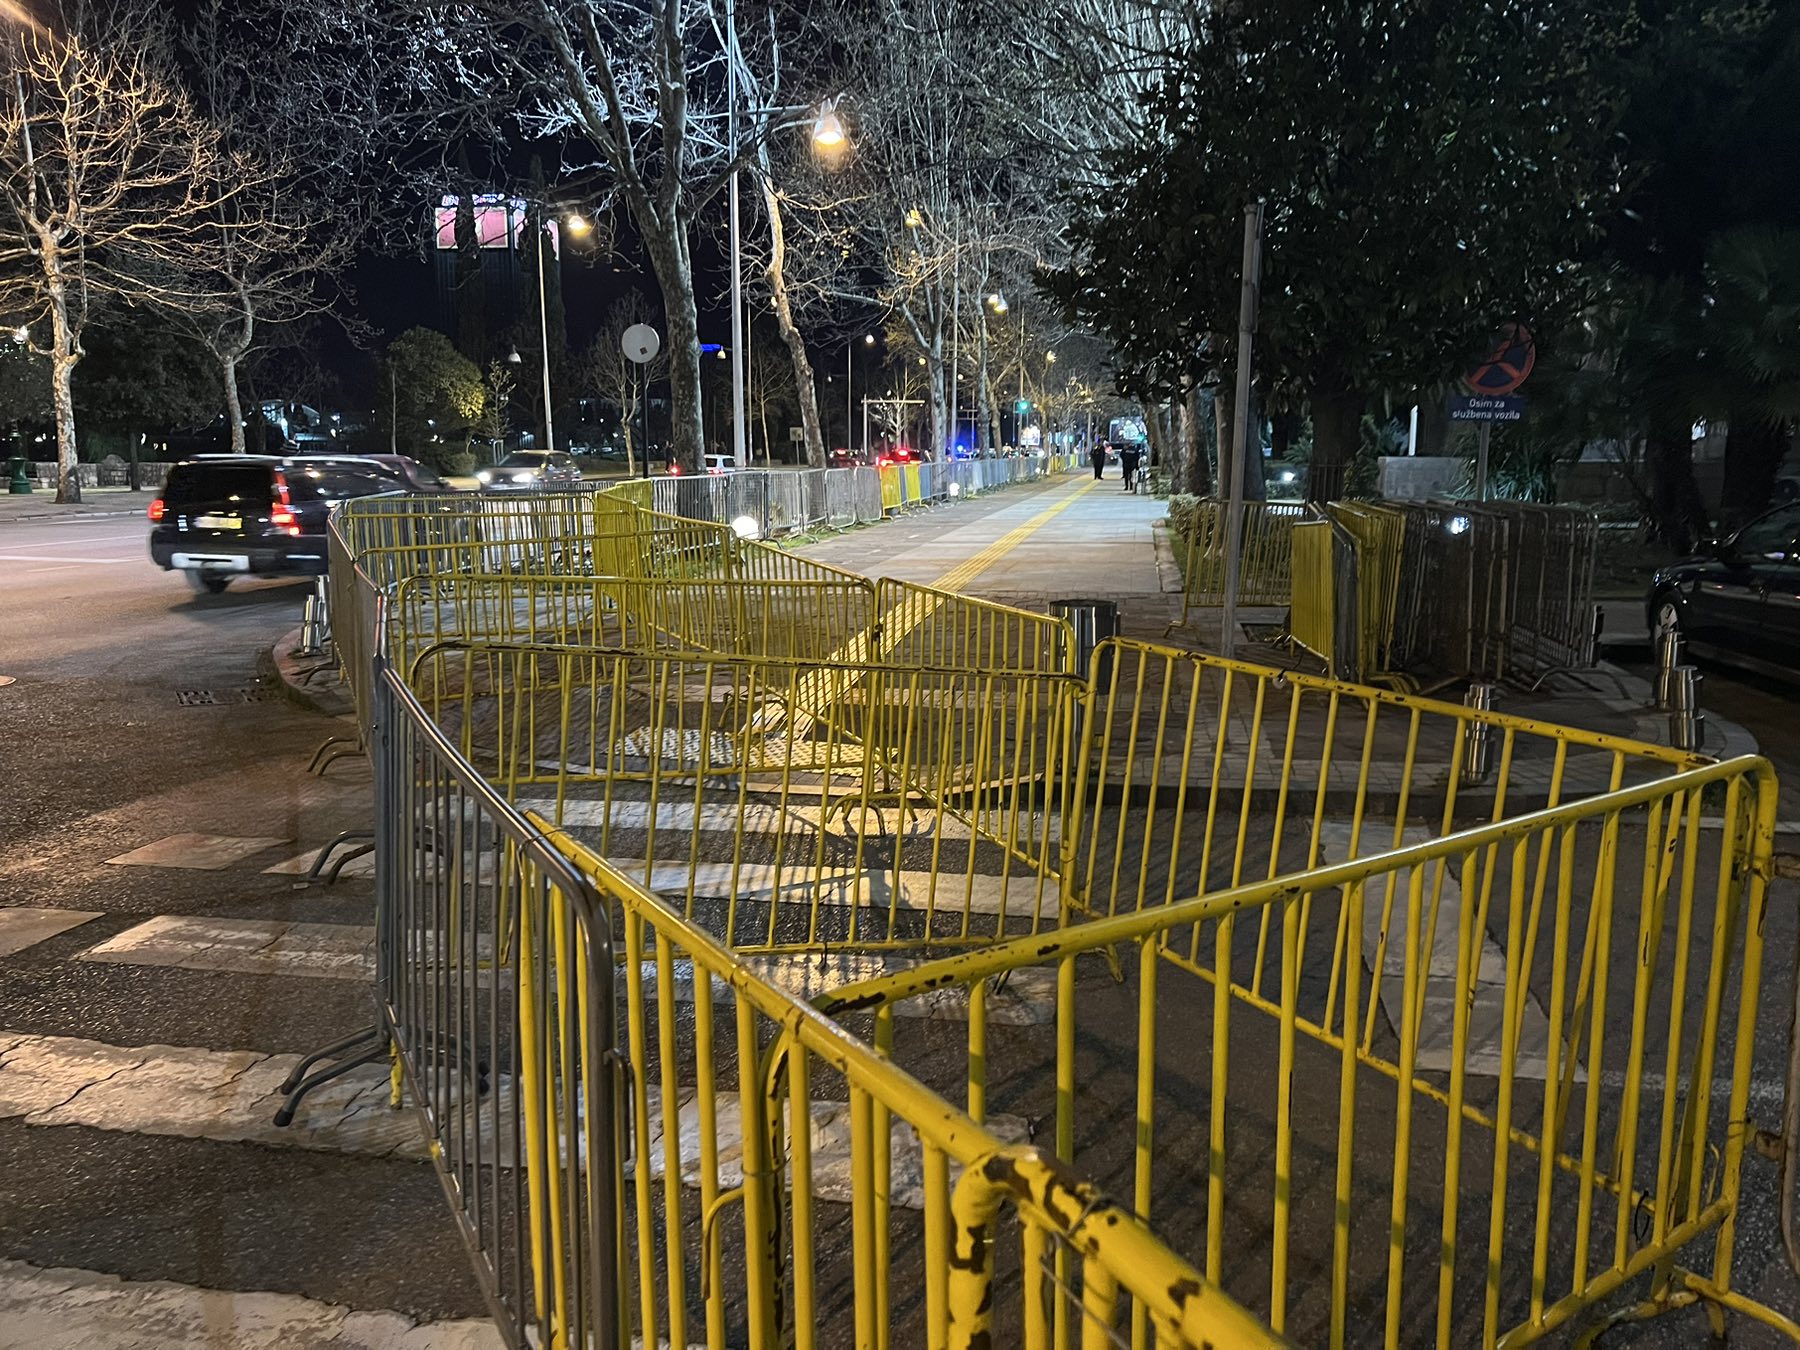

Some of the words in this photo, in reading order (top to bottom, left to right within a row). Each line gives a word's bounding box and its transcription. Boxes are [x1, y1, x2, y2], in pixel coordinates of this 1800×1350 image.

[1469, 398, 1492, 408] Osim
[1494, 400, 1505, 408] za
[1452, 410, 1492, 419] službena
[1494, 410, 1520, 420] vozila
